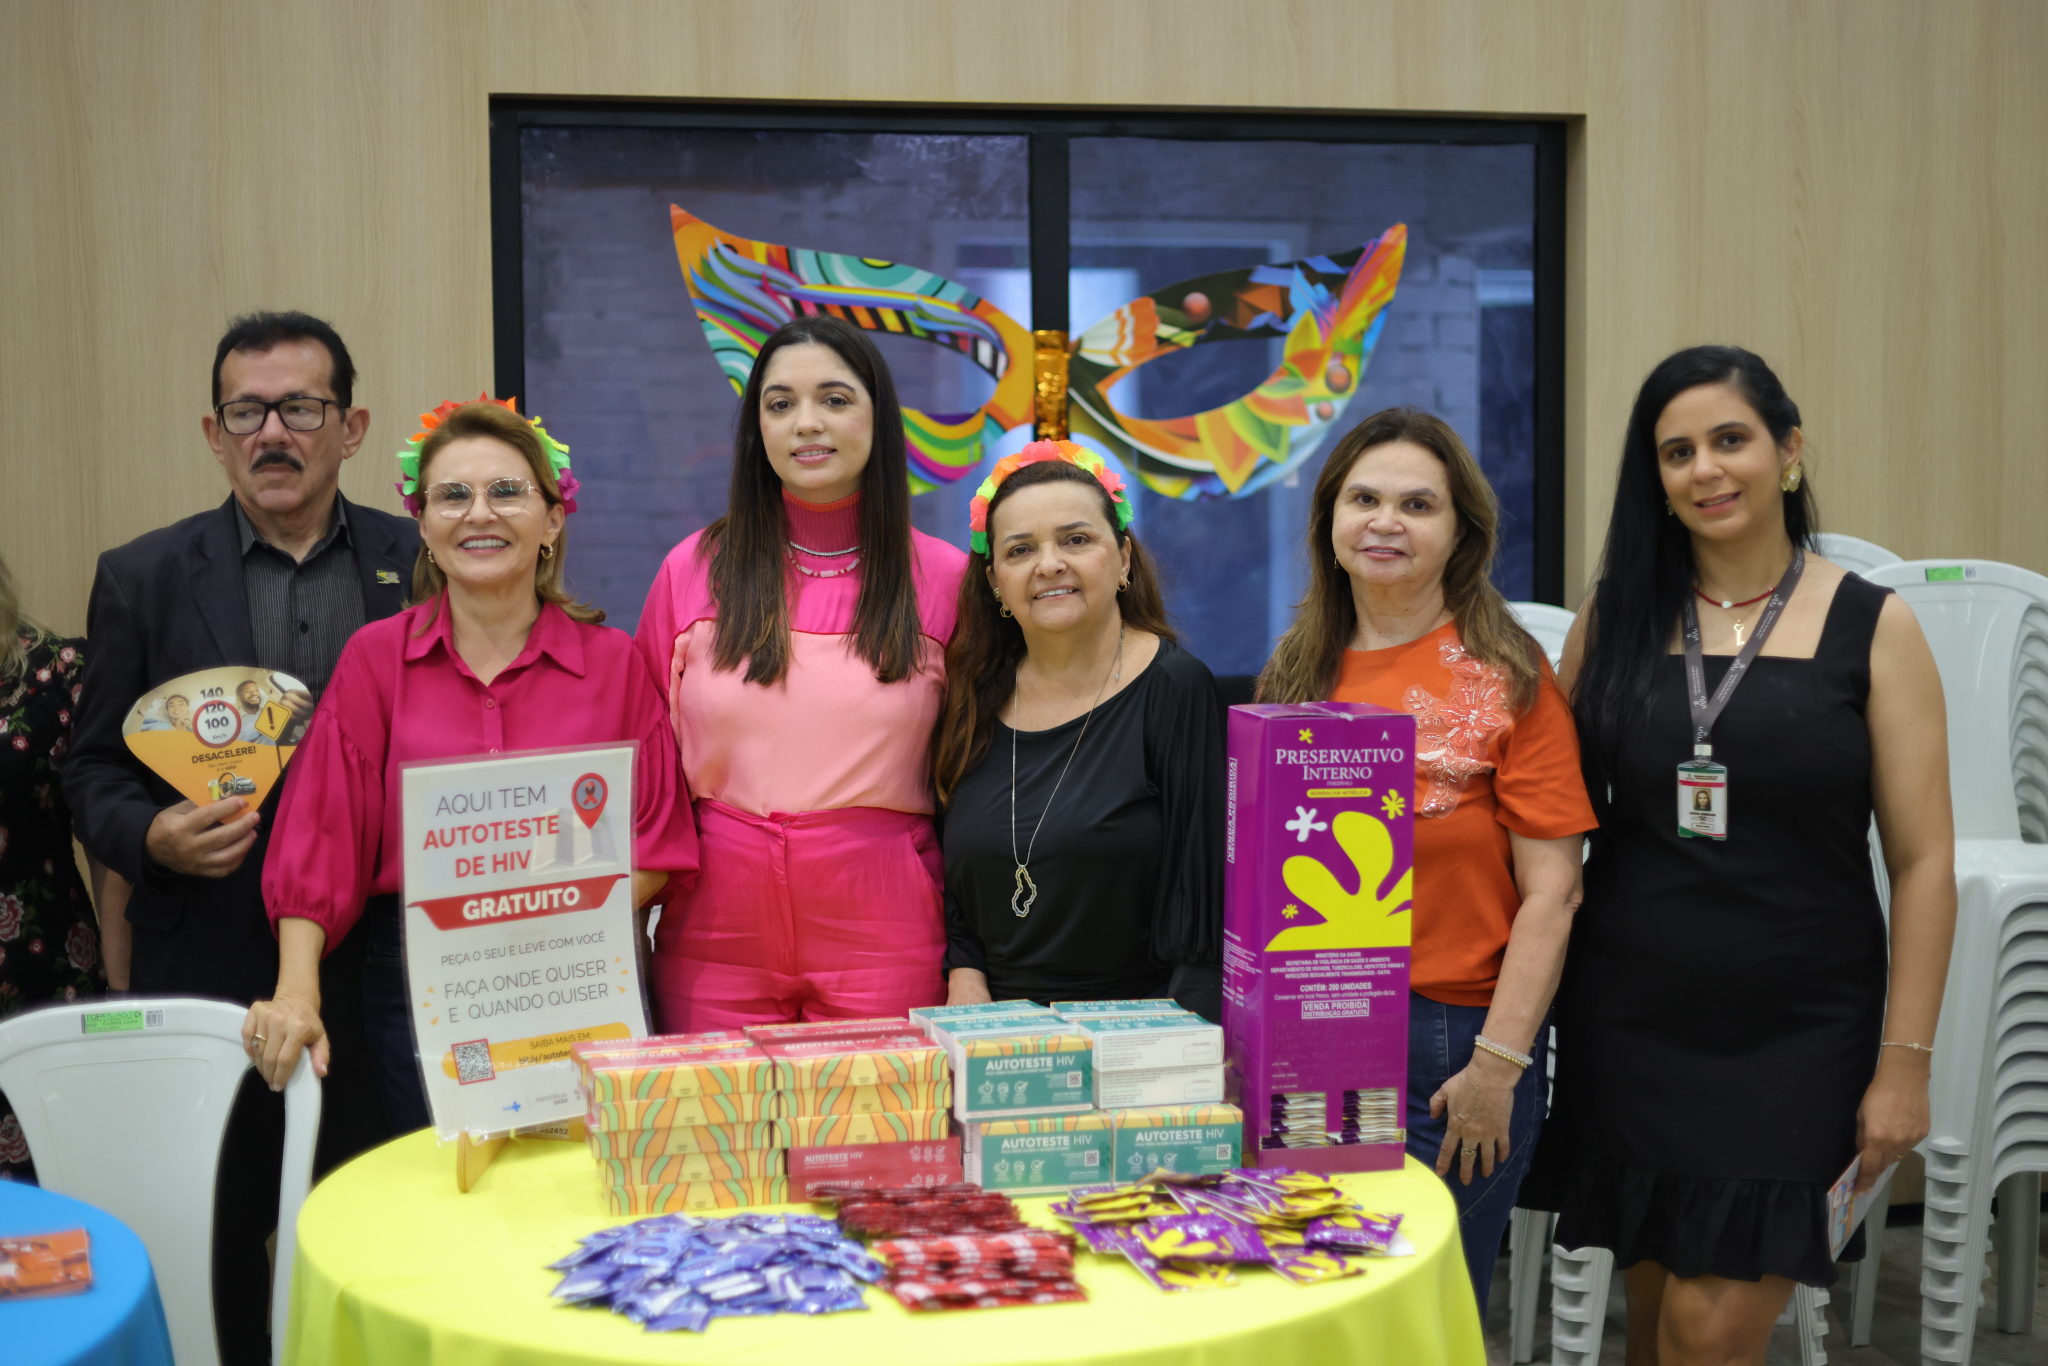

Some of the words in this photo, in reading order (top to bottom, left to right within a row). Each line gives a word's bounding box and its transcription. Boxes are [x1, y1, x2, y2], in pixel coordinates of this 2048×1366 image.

[200, 686, 224, 700] 140
[203, 702, 226, 715] 120
[204, 716, 229, 730] 100
[191, 746, 257, 764] DESACELERE!
[1275, 748, 1404, 765] PRESERVATIVO
[1302, 765, 1373, 781] INTERNO
[435, 790, 492, 817] AQUI
[498, 784, 547, 809] TEM
[422, 814, 560, 851] AUTOTESTE
[455, 855, 486, 879] DE
[492, 849, 532, 874] HIV
[462, 886, 580, 921] GRATUITO
[441, 952, 471, 967] PEÇA
[472, 951, 482, 961] O
[484, 947, 506, 960] SEU
[509, 945, 516, 956] E
[518, 941, 547, 955] LEVE
[548, 936, 574, 950] COM
[576, 929, 606, 945] VOCÊ
[444, 978, 490, 999] FAÇA
[492, 969, 542, 991] ONDE
[545, 959, 607, 983] QUISER
[1300, 983, 1327, 992] CONTÉM:
[1328, 983, 1340, 991] 200
[1340, 982, 1372, 991] UNIDADES
[448, 1007, 460, 1023] E
[468, 993, 544, 1020] QUANDO
[548, 983, 609, 1006] QUISER
[1304, 1002, 1330, 1011] VENDA
[1332, 1001, 1368, 1010] PROIBIDA
[529, 1038, 555, 1050] SAIBA
[555, 1034, 577, 1044] MAIS
[577, 1031, 592, 1041] EM:
[985, 1056, 1054, 1071] AUTOTESTE
[1056, 1055, 1075, 1067] HIV
[1001, 1135, 1070, 1150] AUTOTESTE
[1073, 1134, 1093, 1146] HIV
[1135, 1129, 1203, 1142] AUTOTESTE
[1206, 1128, 1225, 1139] HIV
[804, 1153, 849, 1163] AUTOTESTE
[850, 1151, 863, 1159] HIV
